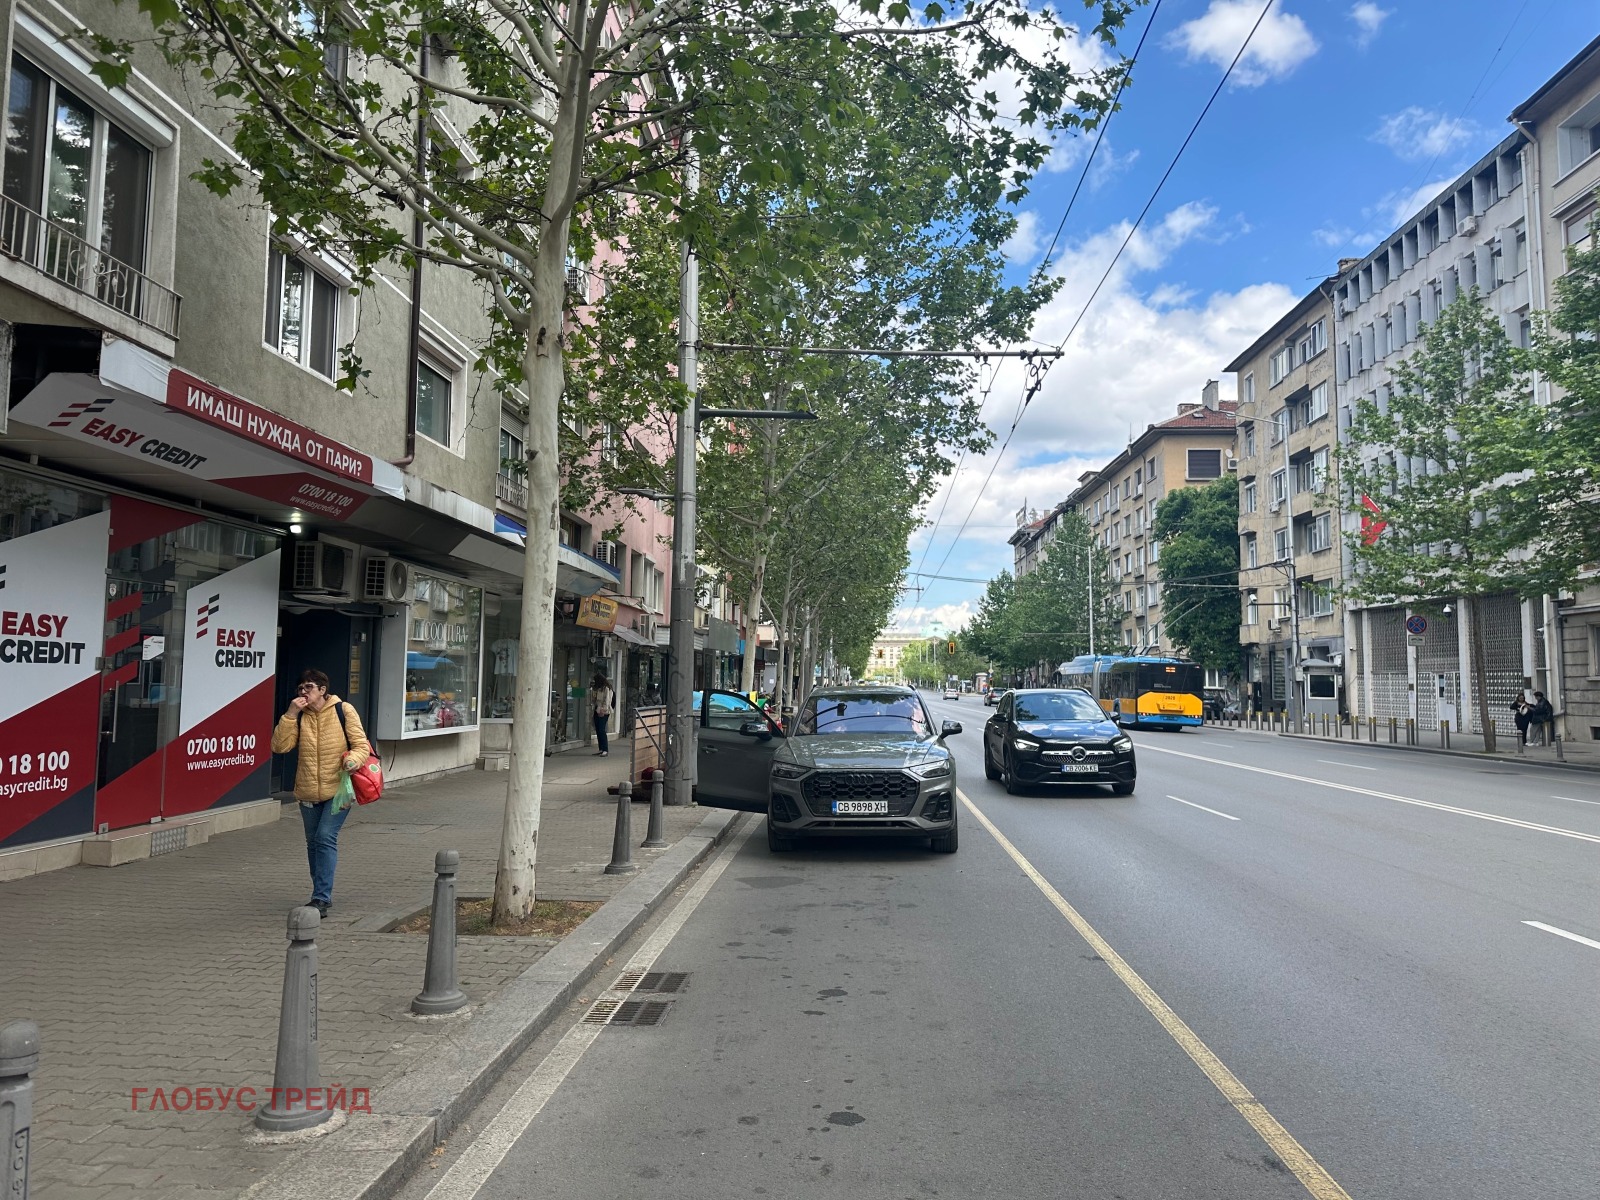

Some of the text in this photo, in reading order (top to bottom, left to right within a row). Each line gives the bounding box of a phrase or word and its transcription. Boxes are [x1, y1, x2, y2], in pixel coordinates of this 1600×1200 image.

[187, 386, 362, 477] ИМАШ НУЖДА ОТ ПАРИ?
[80, 417, 207, 470] EASY CREDIT
[290, 495, 342, 517] www.easycredit.bg
[298, 483, 353, 507] 0700 18 100
[1, 610, 69, 638] EASY
[216, 628, 255, 648] EASY
[0, 638, 86, 665] CREDIT
[215, 649, 265, 668] CREDIT
[187, 734, 256, 756] 0700 18 100
[9, 753, 32, 775] 18
[37, 750, 70, 772] 100
[187, 753, 255, 771] www.easycredit.bg
[837, 802, 887, 812] CB 9898 XH
